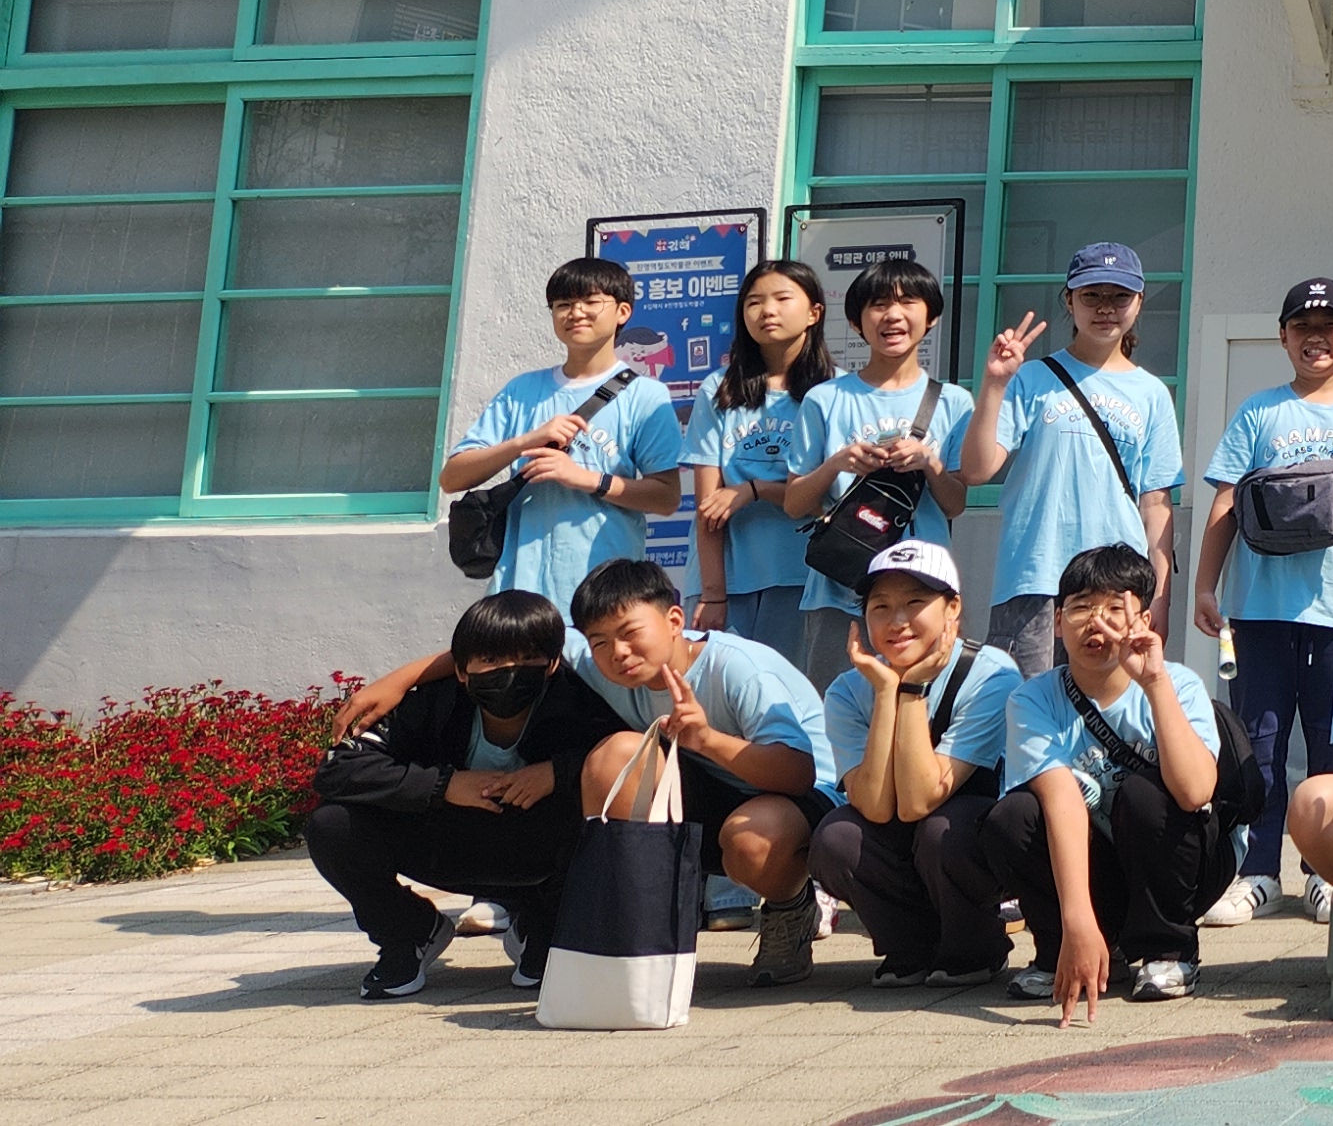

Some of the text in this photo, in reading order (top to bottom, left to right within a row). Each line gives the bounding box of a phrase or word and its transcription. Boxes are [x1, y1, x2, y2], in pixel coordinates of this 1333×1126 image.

[833, 252, 863, 265] 박물관
[649, 278, 684, 300] 홍보
[688, 274, 739, 298] 이벤트
[1106, 411, 1131, 430] three
[723, 418, 795, 450] CHAMP
[1282, 444, 1313, 460] CLASS
